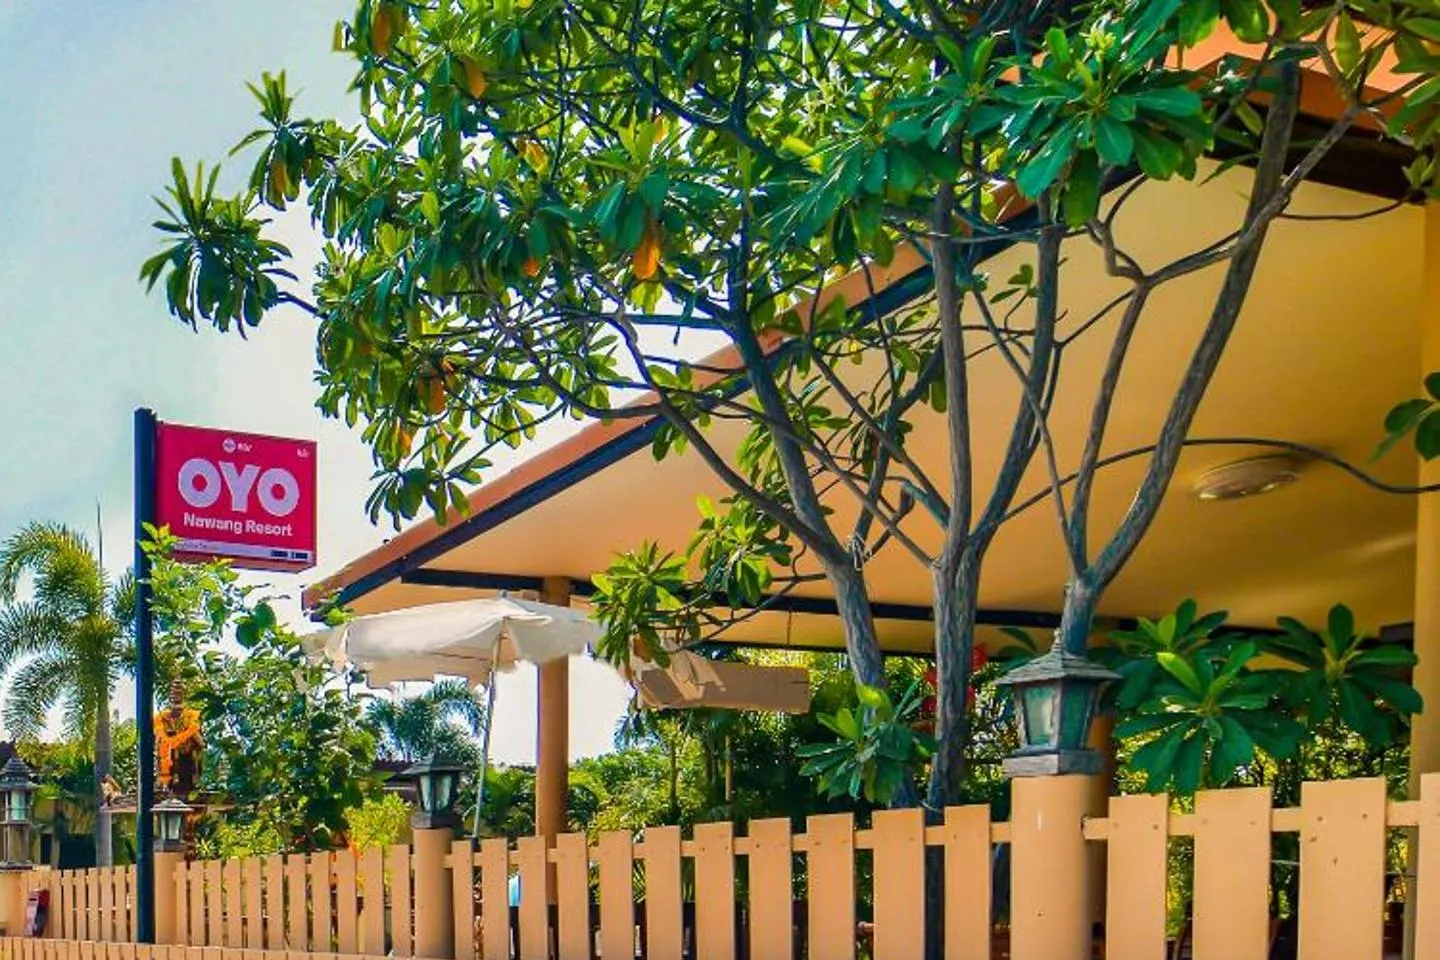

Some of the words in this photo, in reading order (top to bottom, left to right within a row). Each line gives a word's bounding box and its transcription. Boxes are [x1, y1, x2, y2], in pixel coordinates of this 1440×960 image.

[178, 458, 300, 517] OYO
[183, 512, 243, 534] Nawang
[245, 519, 293, 537] Resort
